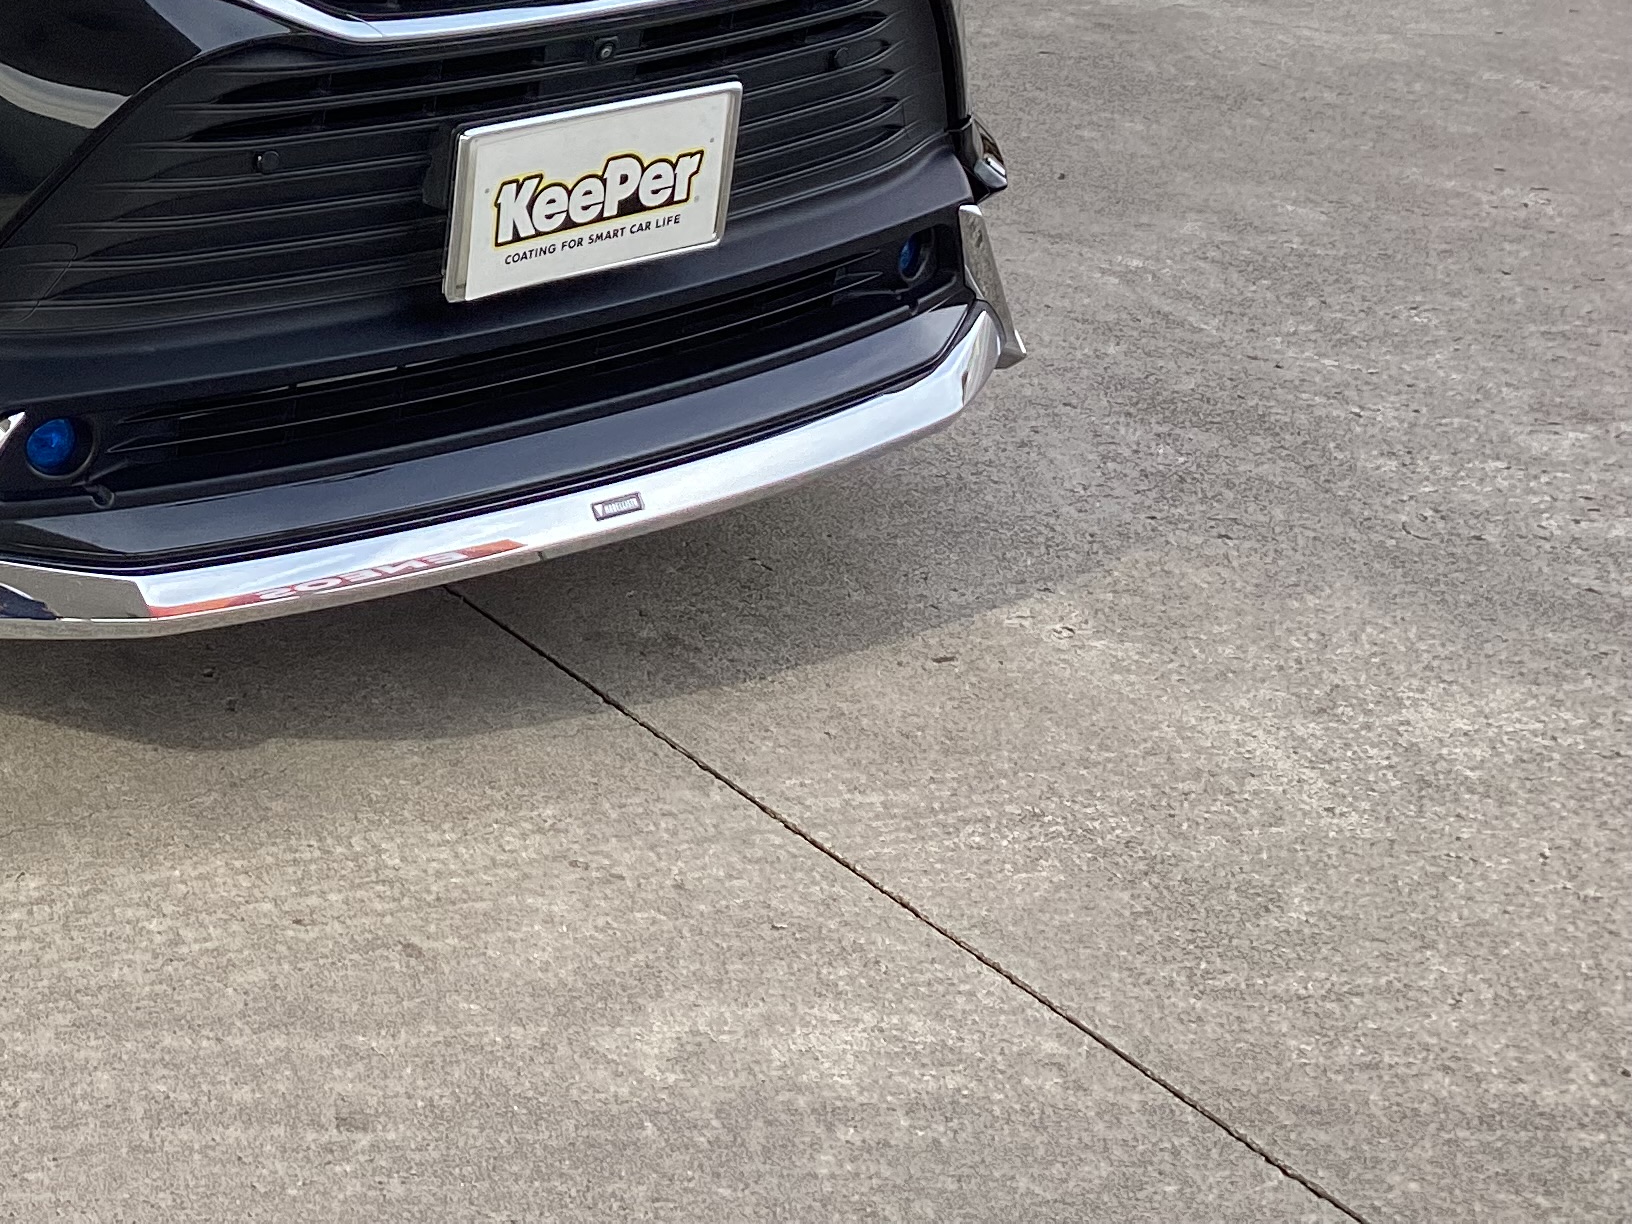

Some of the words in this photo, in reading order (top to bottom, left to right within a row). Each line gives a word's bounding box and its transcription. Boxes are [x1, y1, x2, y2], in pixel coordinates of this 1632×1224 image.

[494, 149, 705, 248] KeePer
[504, 243, 557, 266] COATING
[561, 236, 584, 252] FOR
[587, 226, 627, 245] SMART
[629, 220, 651, 235] CAR
[655, 213, 682, 229] LIFE
